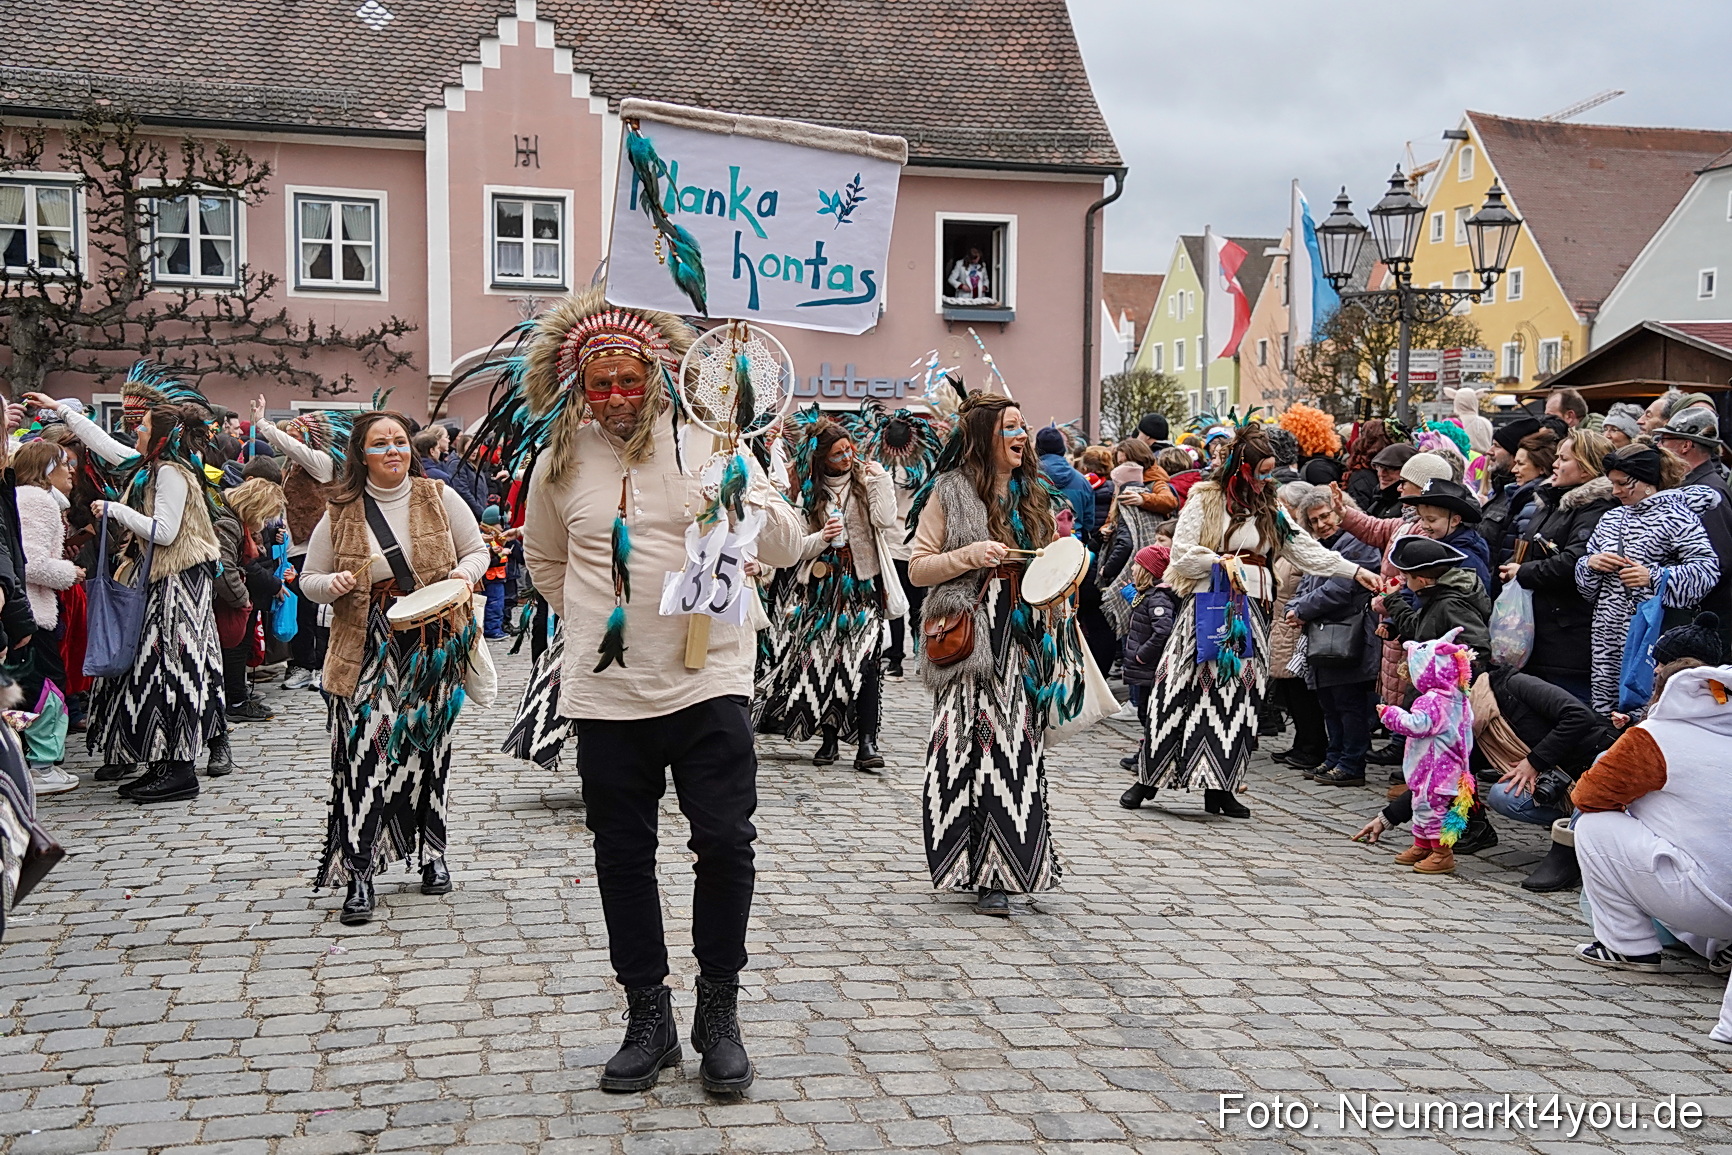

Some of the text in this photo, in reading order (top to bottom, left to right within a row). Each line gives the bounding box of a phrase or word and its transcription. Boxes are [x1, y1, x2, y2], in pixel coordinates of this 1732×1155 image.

[732, 231, 876, 311] hontas
[763, 361, 916, 398] utter
[681, 551, 738, 613] 35
